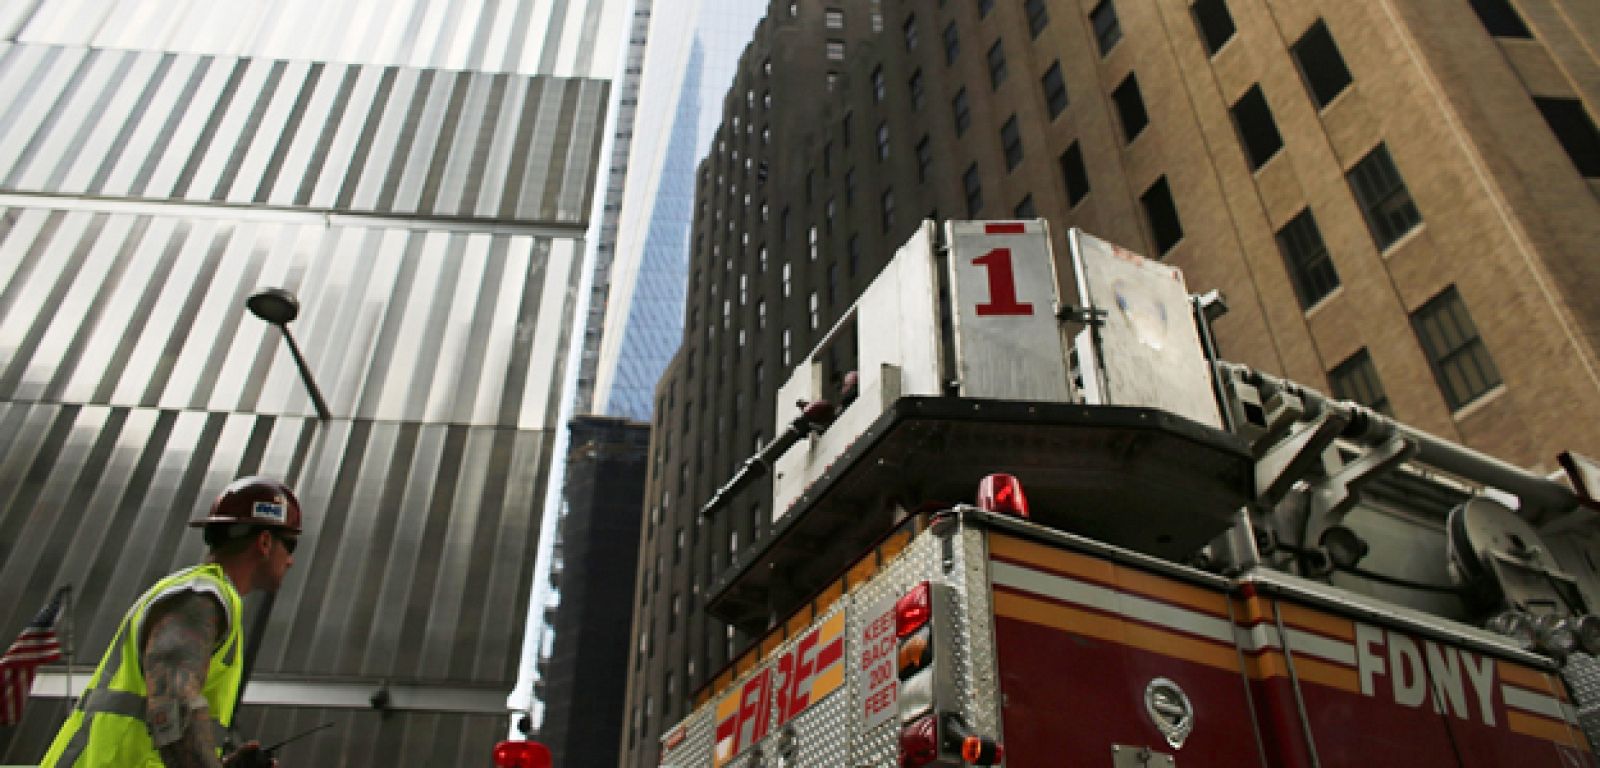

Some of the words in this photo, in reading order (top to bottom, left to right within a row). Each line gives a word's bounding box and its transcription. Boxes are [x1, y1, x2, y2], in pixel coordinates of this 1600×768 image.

[970, 247, 1034, 316] 1
[862, 606, 897, 645] KEEP
[862, 634, 897, 672] BACK
[732, 629, 821, 758] FIRE
[869, 660, 892, 691] 200
[1355, 621, 1496, 728] FDNY
[864, 681, 897, 718] FEET
